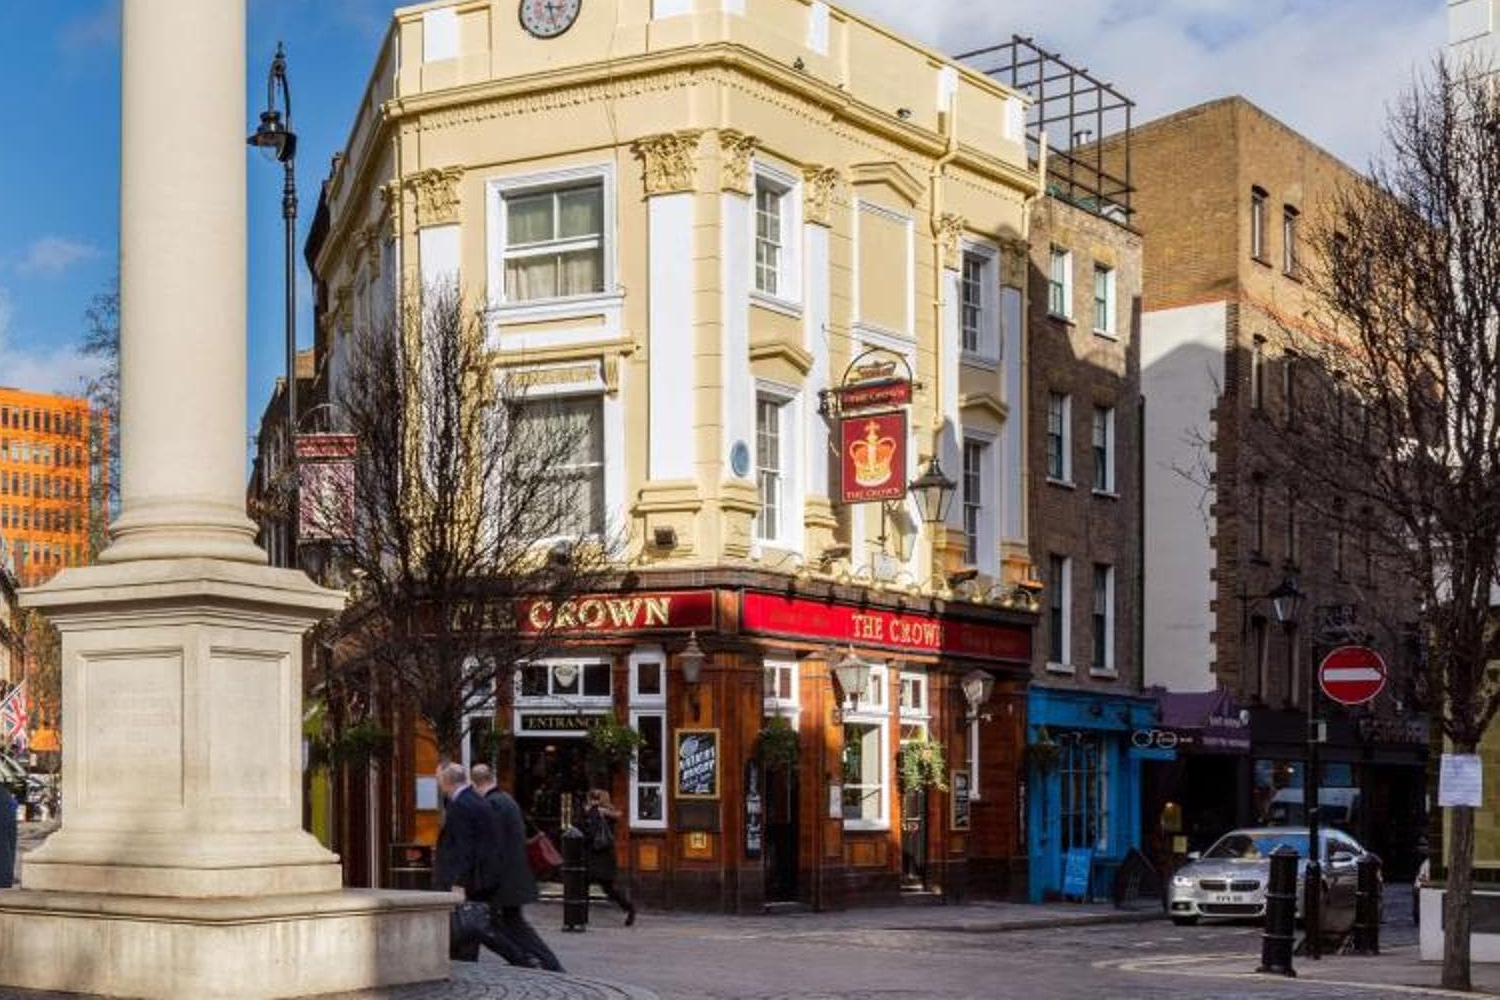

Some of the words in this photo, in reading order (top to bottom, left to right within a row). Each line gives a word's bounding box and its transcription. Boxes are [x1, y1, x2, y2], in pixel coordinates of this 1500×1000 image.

[529, 597, 672, 629] CROWN
[851, 614, 884, 640] THE
[890, 618, 945, 647] CROWN
[528, 717, 603, 729] ENTRANCE
